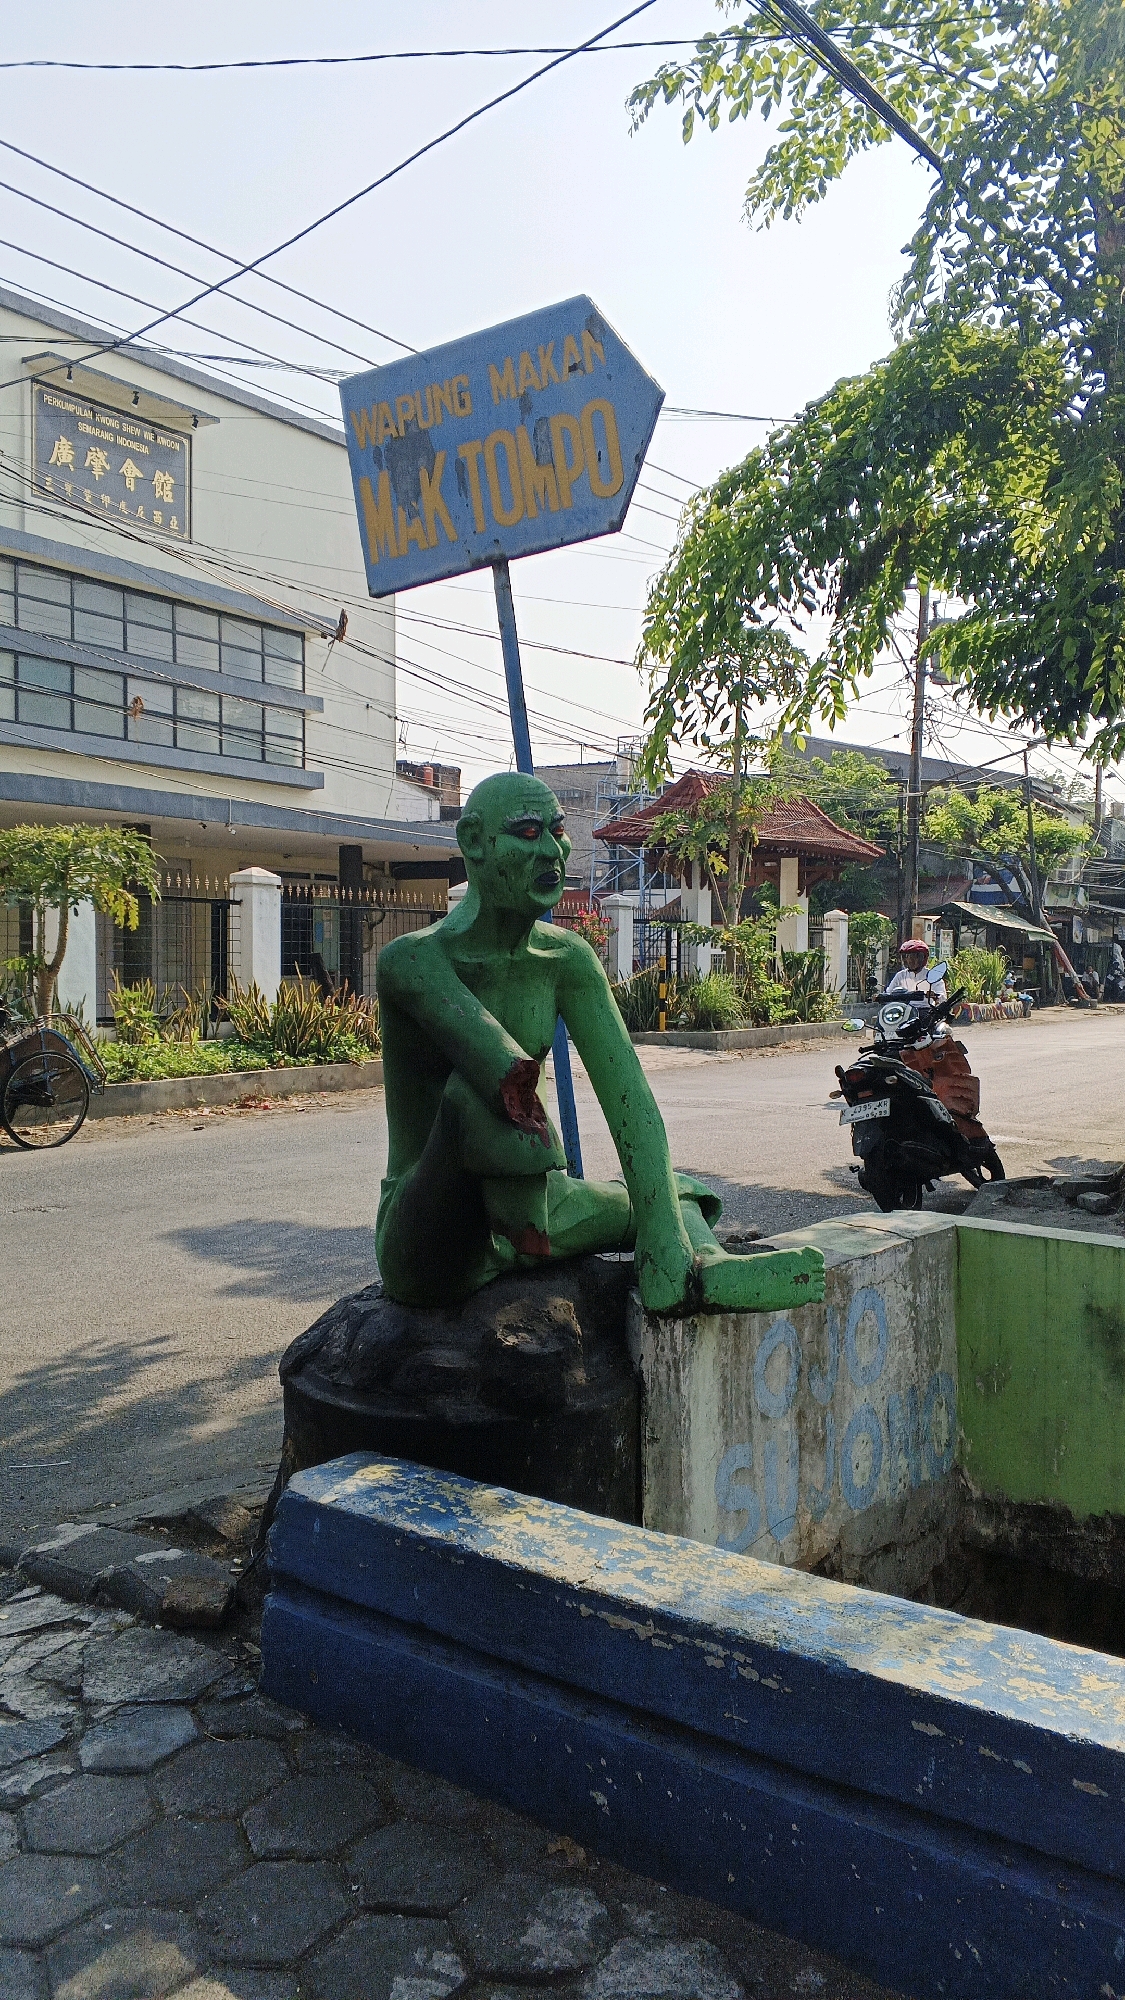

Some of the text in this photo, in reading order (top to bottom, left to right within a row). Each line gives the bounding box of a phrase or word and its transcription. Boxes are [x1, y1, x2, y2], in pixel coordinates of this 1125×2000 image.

[488, 329, 607, 405] MAKAN
[43, 394, 93, 420] PERKUMPULAN
[95, 413, 119, 429] KWONG
[77, 421, 150, 455] SEMARANG INDONESIA
[49, 435, 175, 503] 廣肇會館
[358, 397, 625, 566] MAK TOMPO
[753, 1286, 889, 1419] OJO
